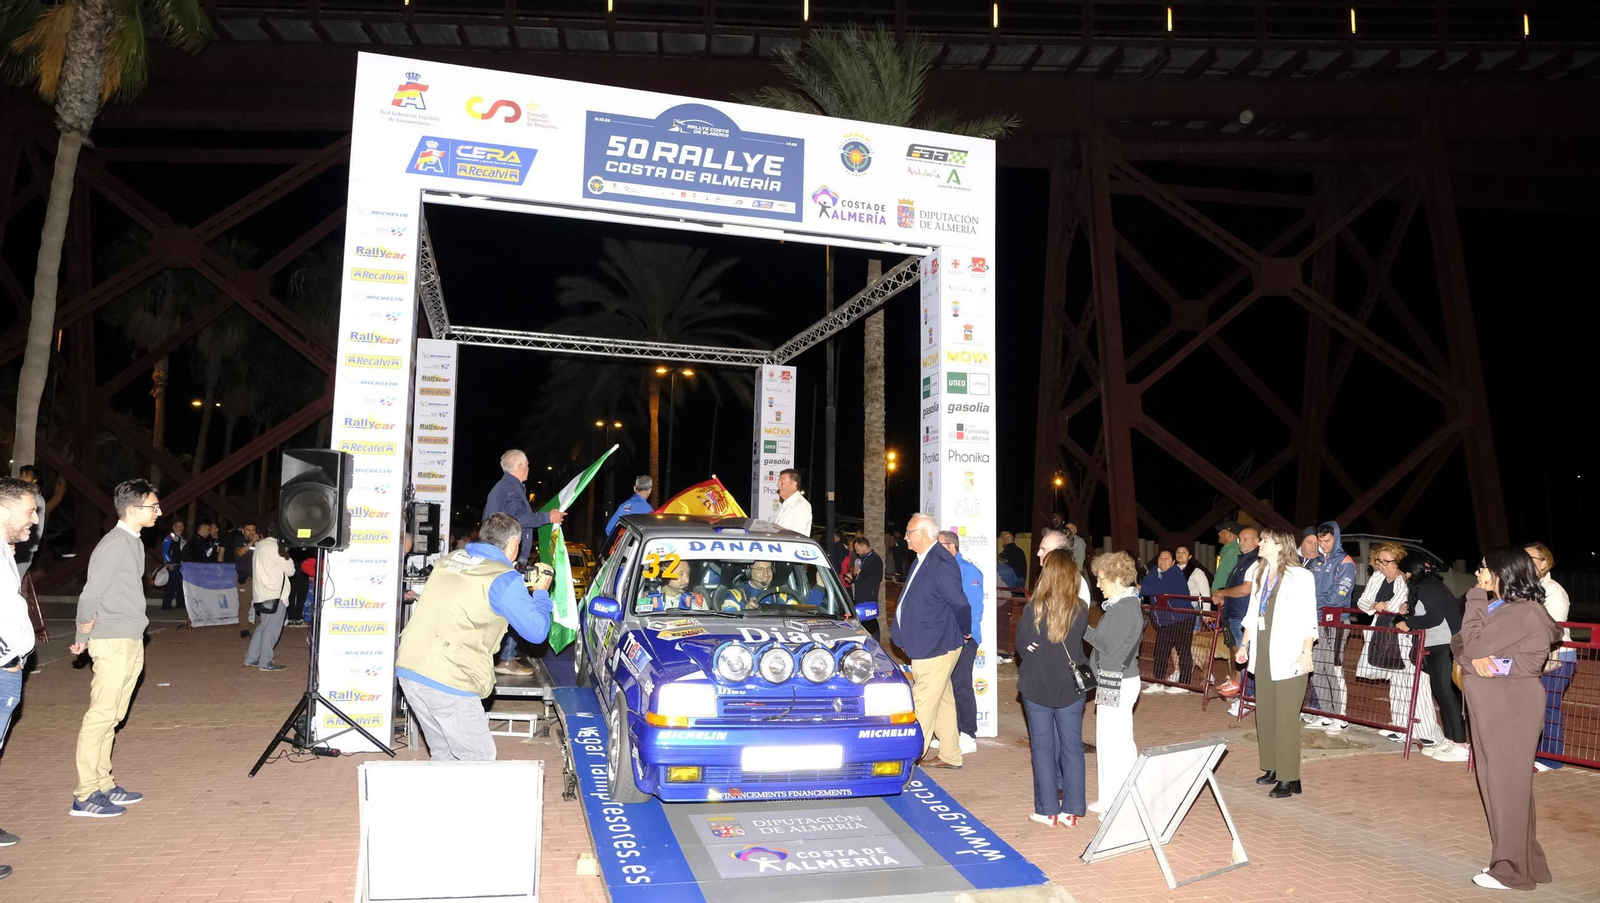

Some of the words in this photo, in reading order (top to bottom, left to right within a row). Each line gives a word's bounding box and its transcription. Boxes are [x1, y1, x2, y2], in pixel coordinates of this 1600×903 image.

[686, 124, 709, 132] RALLYE
[455, 144, 522, 164] CERA
[605, 135, 649, 160] 50
[652, 141, 785, 177] RALLYE
[468, 166, 509, 180] Recalvi
[605, 160, 667, 179] COSTA
[670, 168, 696, 182] DE
[699, 173, 782, 192] ALMERÍA
[841, 200, 872, 211] COSTA
[873, 204, 886, 212] DE
[371, 210, 409, 218] MICHELIN
[831, 209, 887, 225] ALMERÍA
[919, 210, 979, 225] DIPUTACIÓN
[919, 220, 932, 230] DE
[934, 222, 977, 235] ALMERÍA
[356, 246, 407, 260] Rallycar
[362, 271, 397, 281] Recalvi
[350, 332, 402, 345] Rallycar
[356, 357, 391, 367] Recalvi
[947, 351, 990, 364] MOYA
[421, 375, 450, 383] Rallycar
[922, 402, 939, 419] gasolia
[947, 402, 990, 414] gasolia
[344, 417, 396, 431] Rallycar
[419, 423, 448, 431] Rallycar
[764, 427, 791, 436] MOYA
[350, 443, 386, 453] Recalvi
[763, 457, 791, 466] gasolia
[948, 449, 990, 463] Phonika
[417, 472, 446, 480] Rallycar
[348, 507, 391, 519] allycar
[688, 541, 783, 553] DANAN
[642, 552, 681, 581] 32
[334, 598, 387, 609] Rallycar
[593, 602, 610, 614] Diac
[864, 608, 877, 617] Diac
[340, 624, 376, 632] Recalvi
[736, 627, 832, 645] Diac
[329, 691, 382, 701] Rallycar
[657, 730, 728, 741] MICHELIN
[858, 728, 917, 739] MICHELIN
[788, 788, 852, 798] FINANCEMENTS
[751, 814, 864, 829] DIPUTACIÓN
[758, 825, 785, 835] DE
[789, 820, 868, 834] ALMERÍA
[795, 849, 858, 860] COSTA
[859, 847, 888, 856] DE
[785, 854, 900, 873] ALMERÍA
